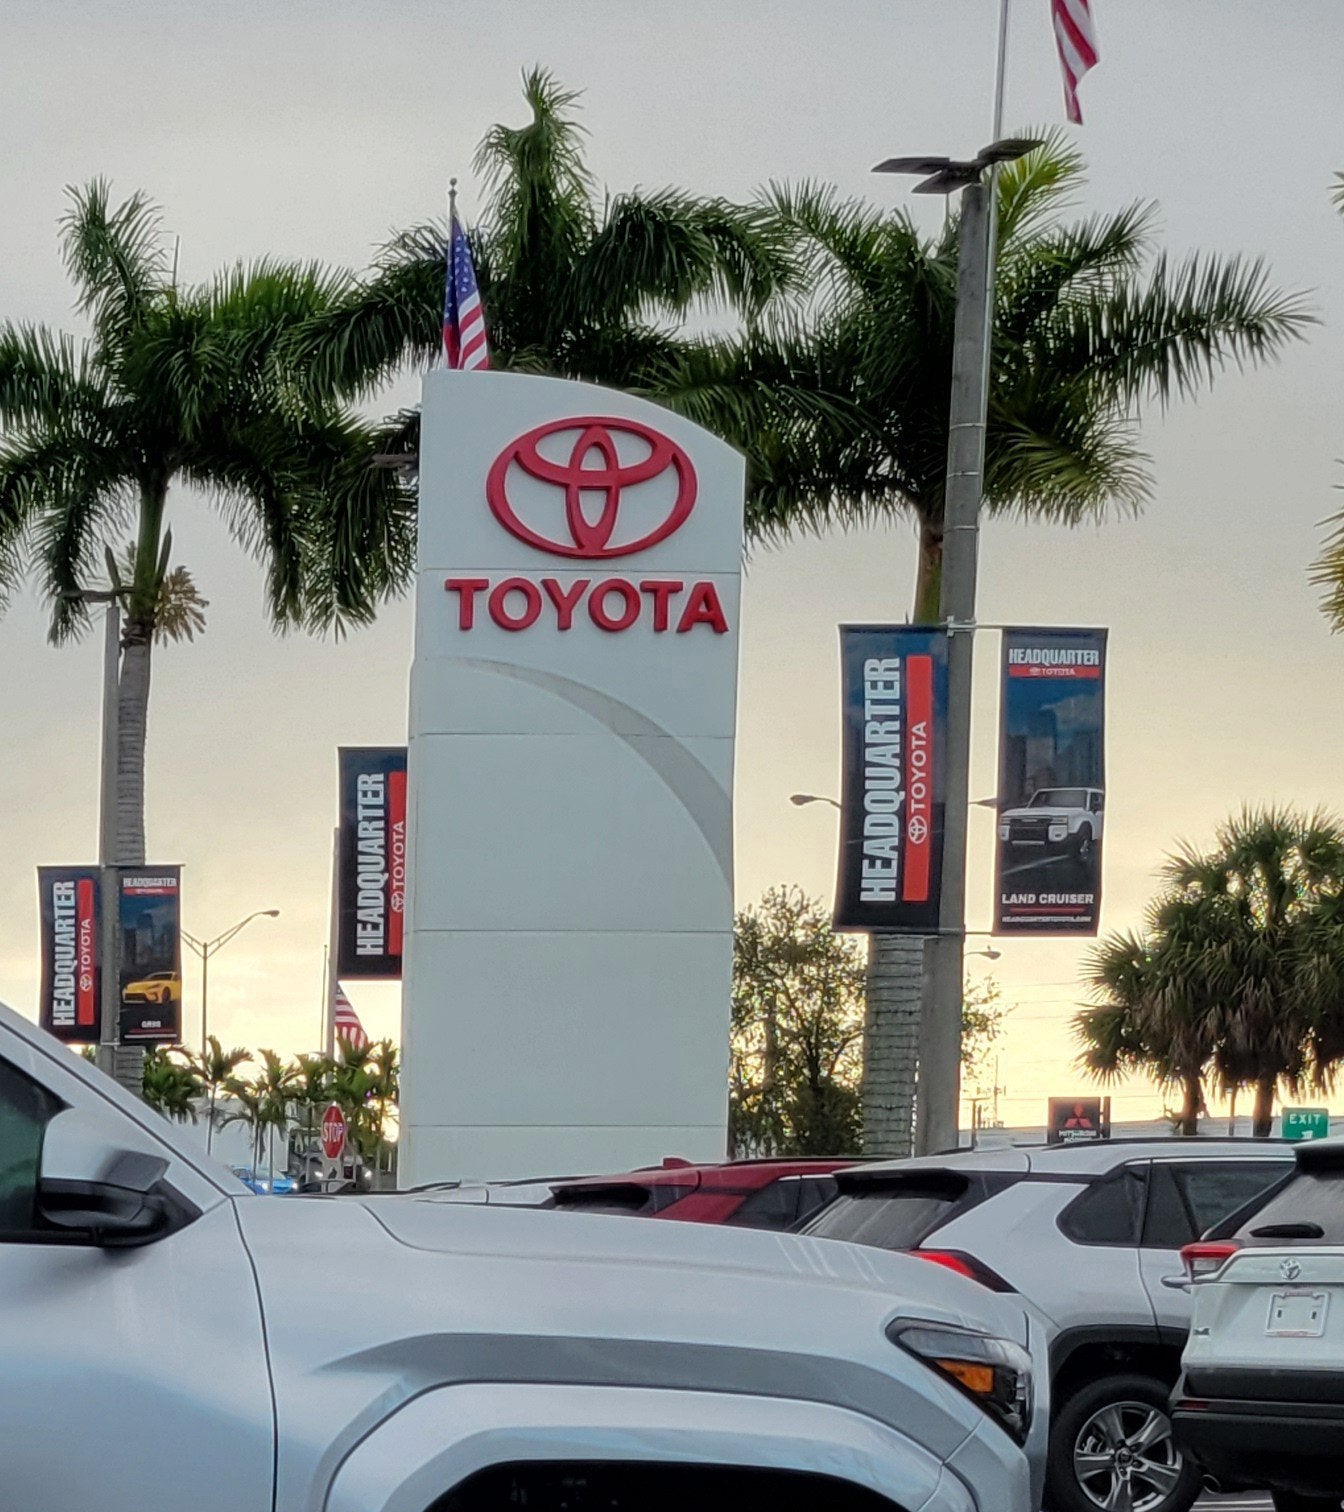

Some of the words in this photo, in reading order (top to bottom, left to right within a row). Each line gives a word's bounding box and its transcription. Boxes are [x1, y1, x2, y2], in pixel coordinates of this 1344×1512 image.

[444, 577, 729, 633] TOYOTA
[1008, 648, 1100, 666] HEADQUARTER
[859, 657, 906, 902] HEADQUARTER
[911, 720, 927, 813] TOYOTA
[356, 772, 389, 956] HEADQUARTER
[393, 820, 405, 890] TOYOTA
[1001, 893, 1037, 904] LAND
[1038, 893, 1095, 904] CRUISER
[52, 880, 78, 1026] HEADQUARTER
[81, 918, 92, 972] TOYOTA
[322, 1121, 344, 1142] STOP
[1289, 1113, 1321, 1125] EXIT
